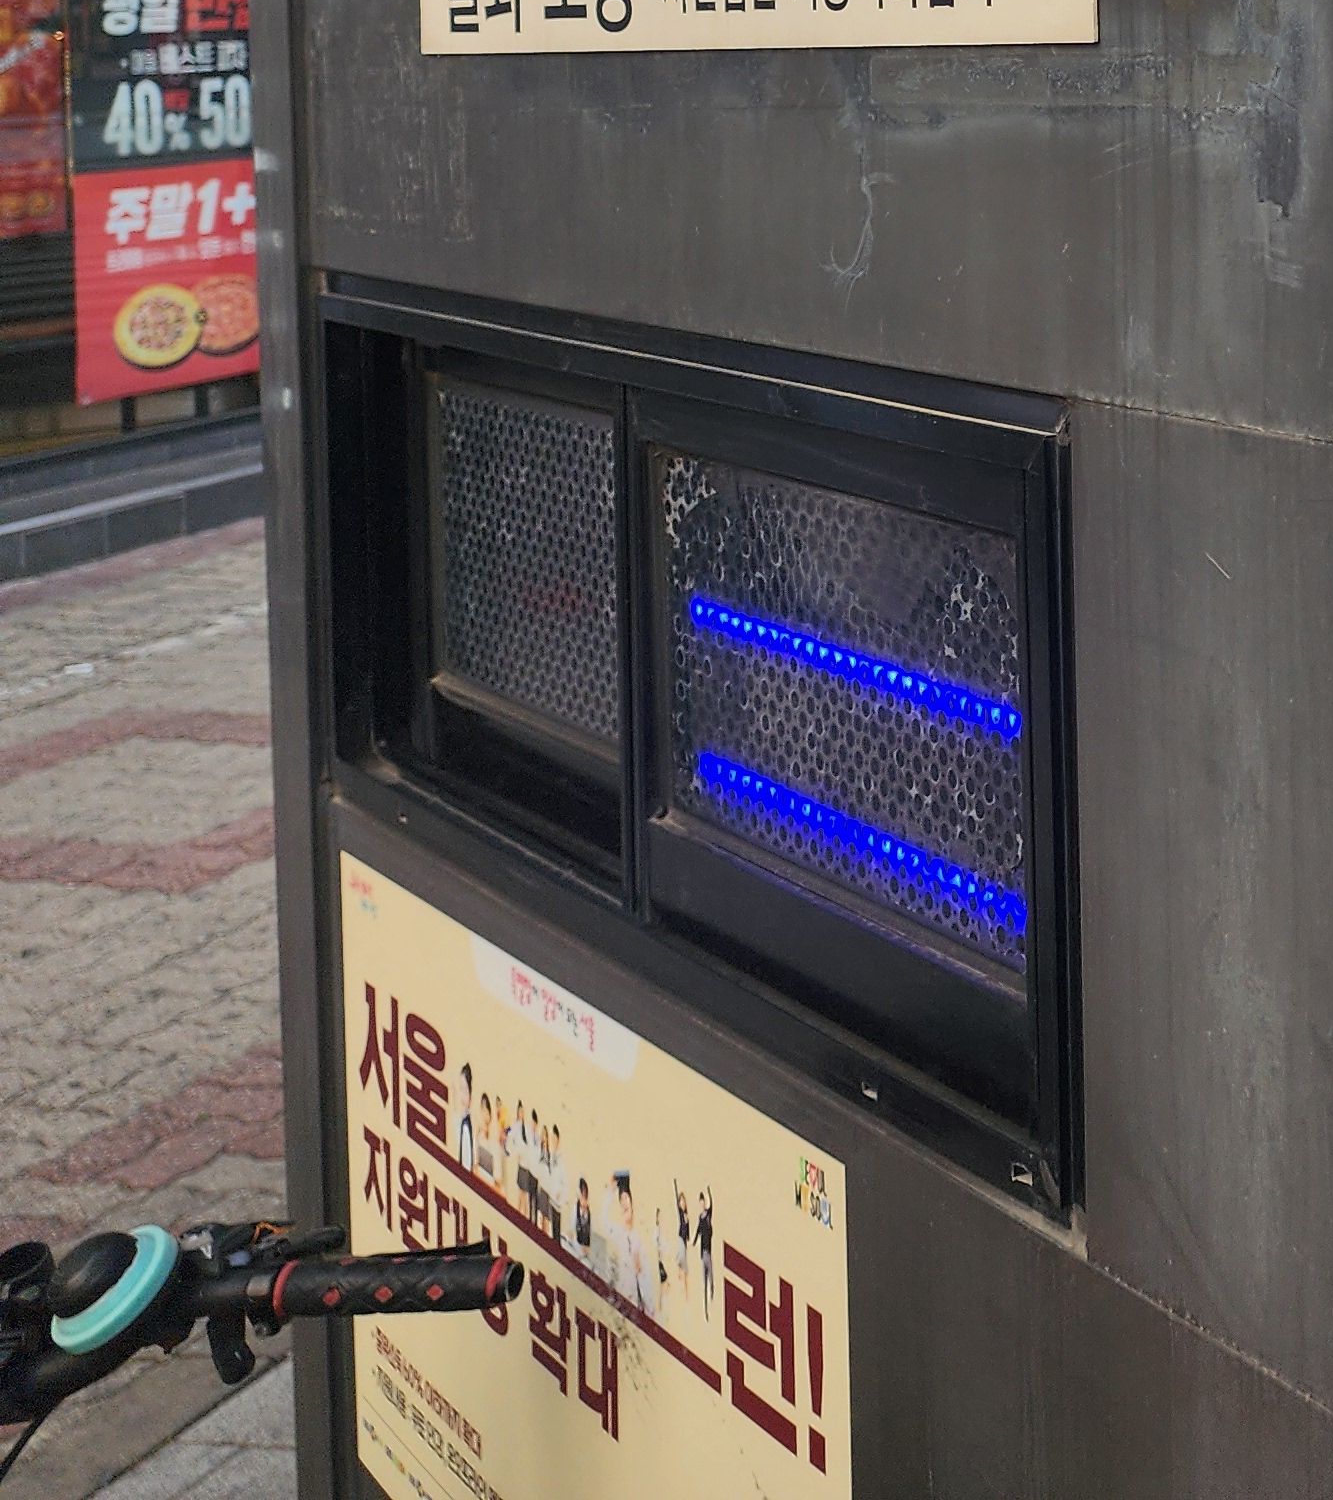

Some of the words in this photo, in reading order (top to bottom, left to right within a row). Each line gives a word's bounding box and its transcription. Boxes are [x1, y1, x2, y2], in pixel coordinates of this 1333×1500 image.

[359, 981, 449, 1150] 서울
[528, 1269, 619, 1443] 확대
[723, 1240, 827, 1476] 런!
